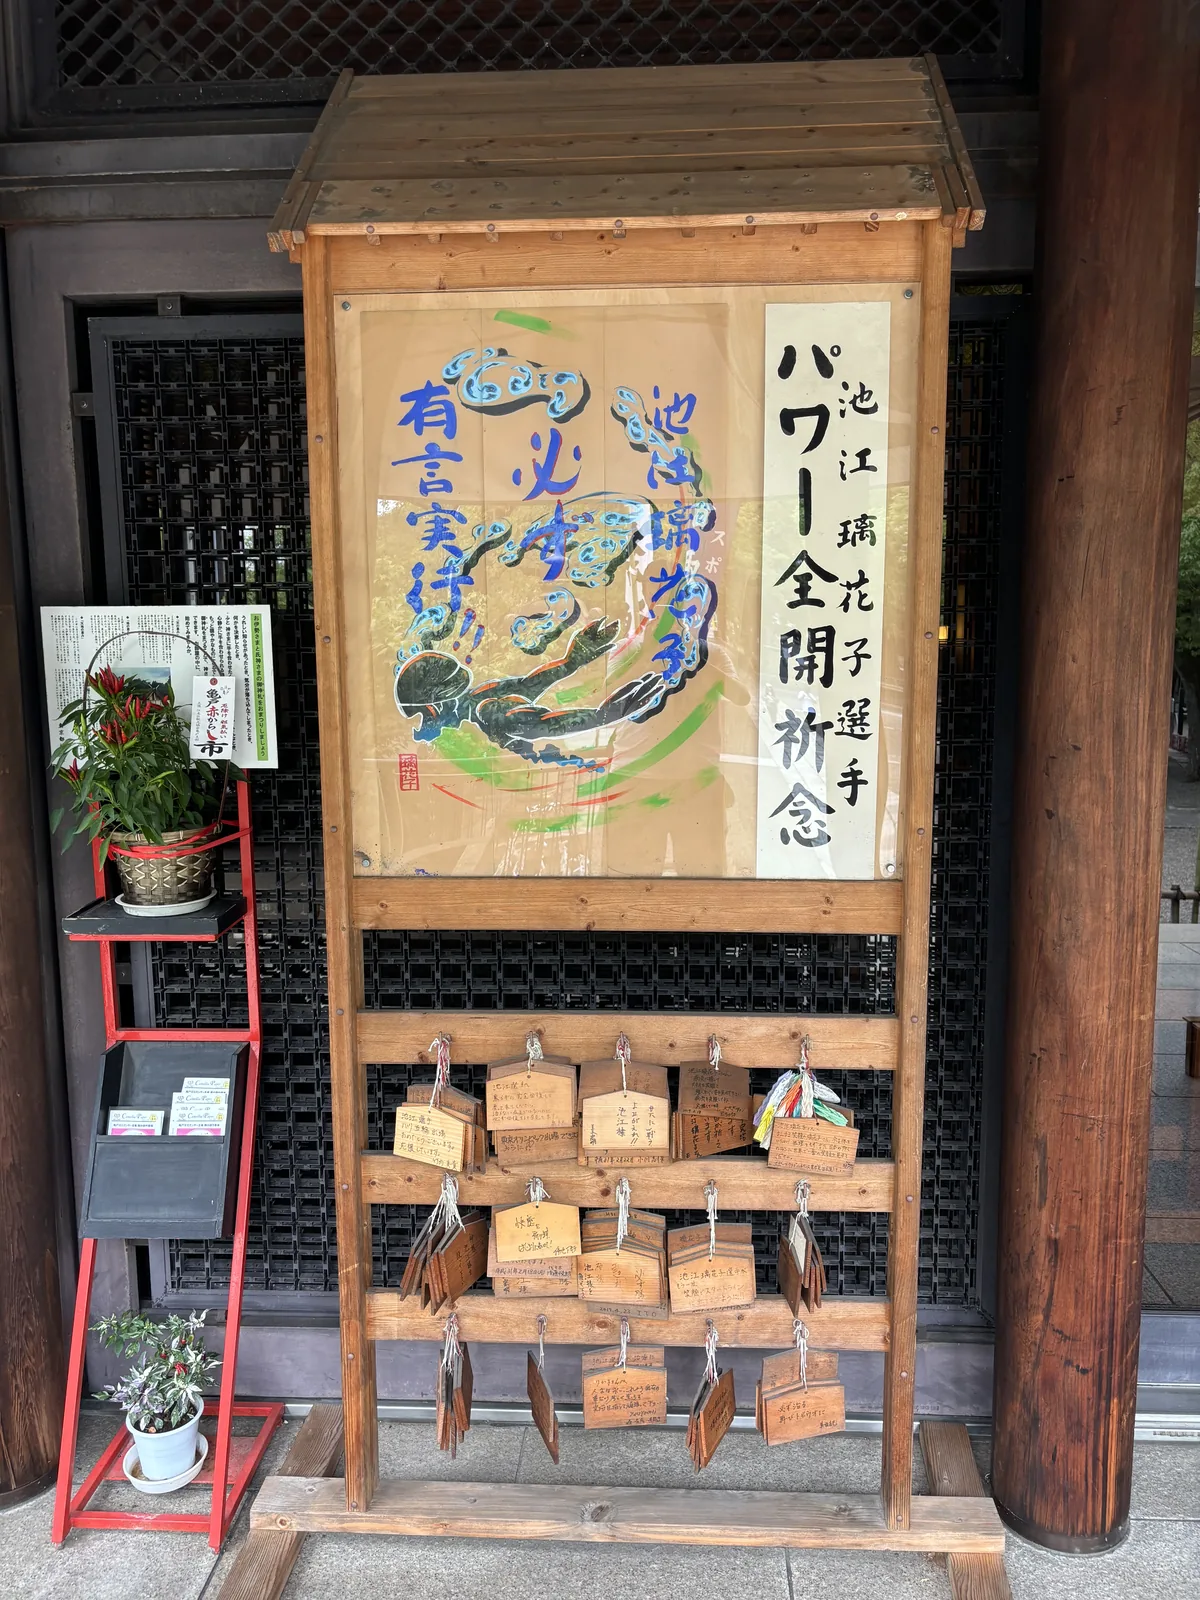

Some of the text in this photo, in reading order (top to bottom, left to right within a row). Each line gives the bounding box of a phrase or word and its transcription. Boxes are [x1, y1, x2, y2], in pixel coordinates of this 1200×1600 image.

[511, 427, 594, 582] 必ず
[768, 344, 841, 847] パワー全開祈念
[835, 381, 879, 807] 池江璃花子選手
